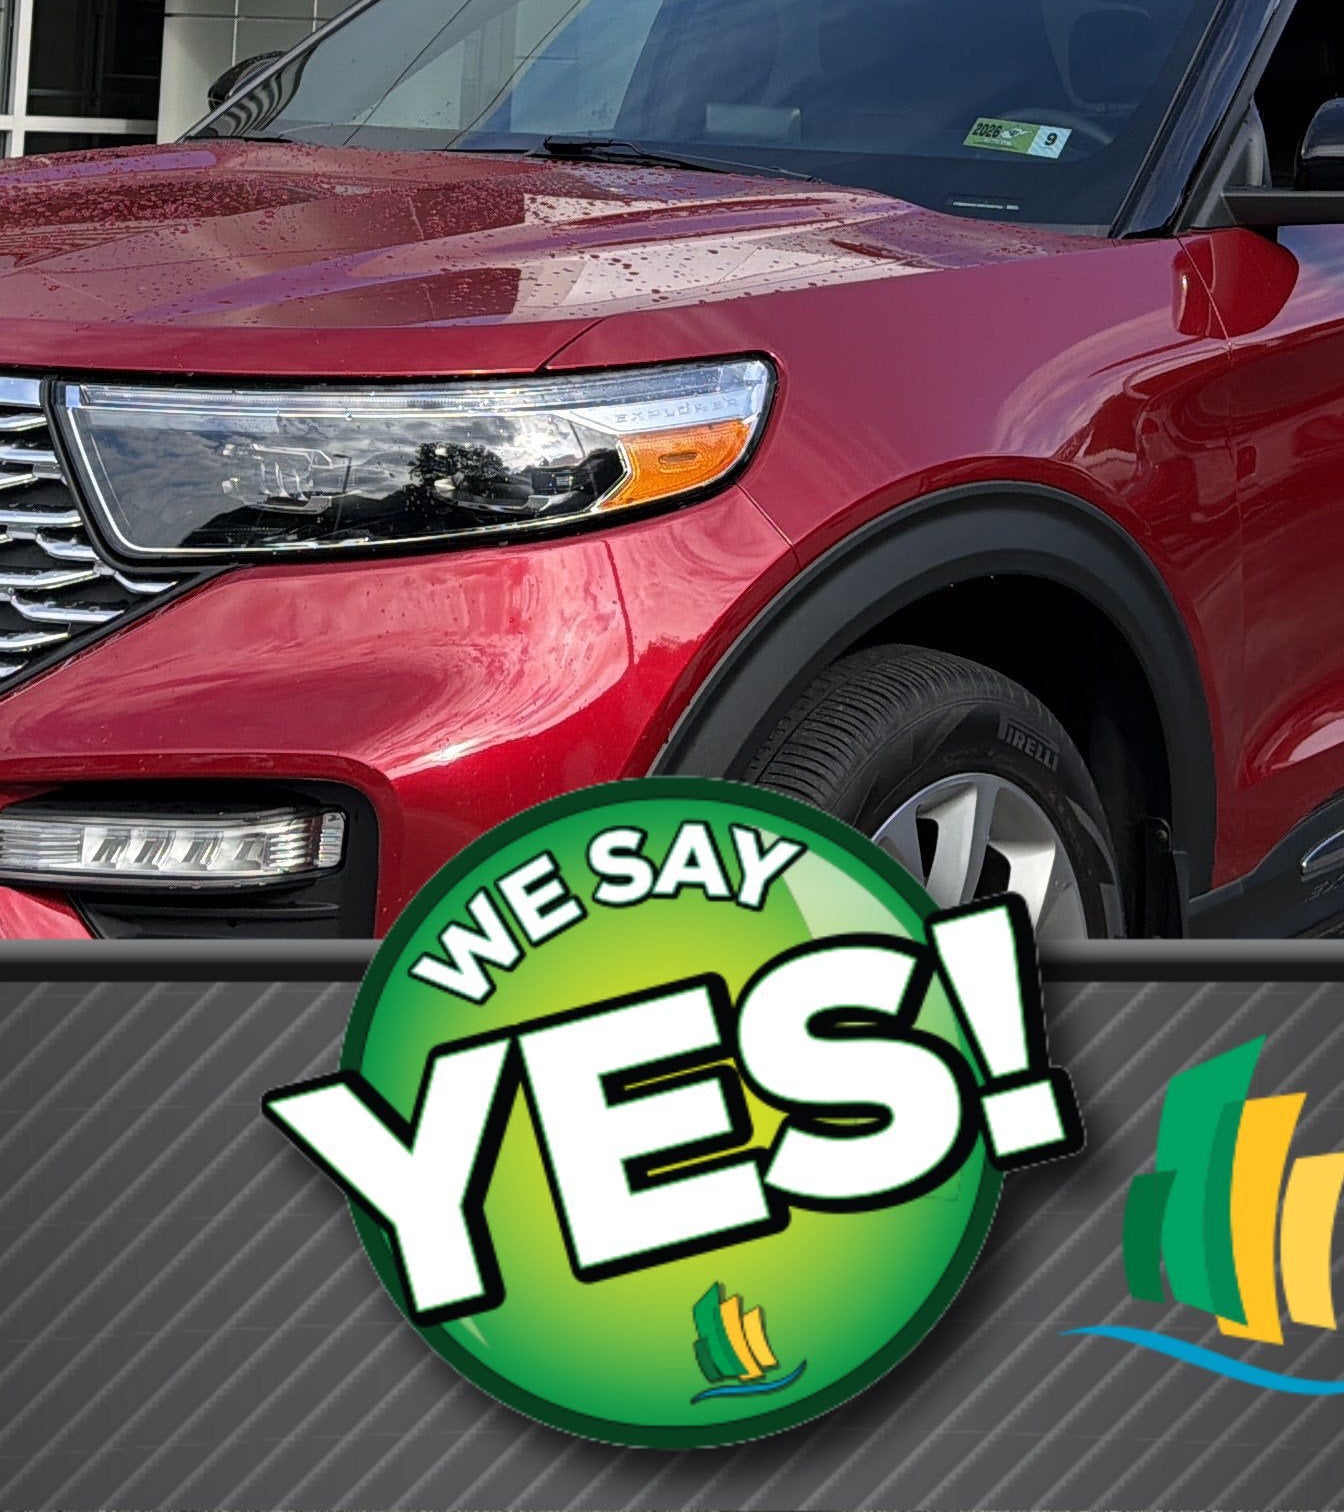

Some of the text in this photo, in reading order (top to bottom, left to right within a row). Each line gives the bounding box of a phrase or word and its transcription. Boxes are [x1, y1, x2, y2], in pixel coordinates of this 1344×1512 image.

[1044, 132, 1058, 146] 9
[614, 396, 739, 424] EXPLORER
[997, 711, 1059, 772] PIRELLI
